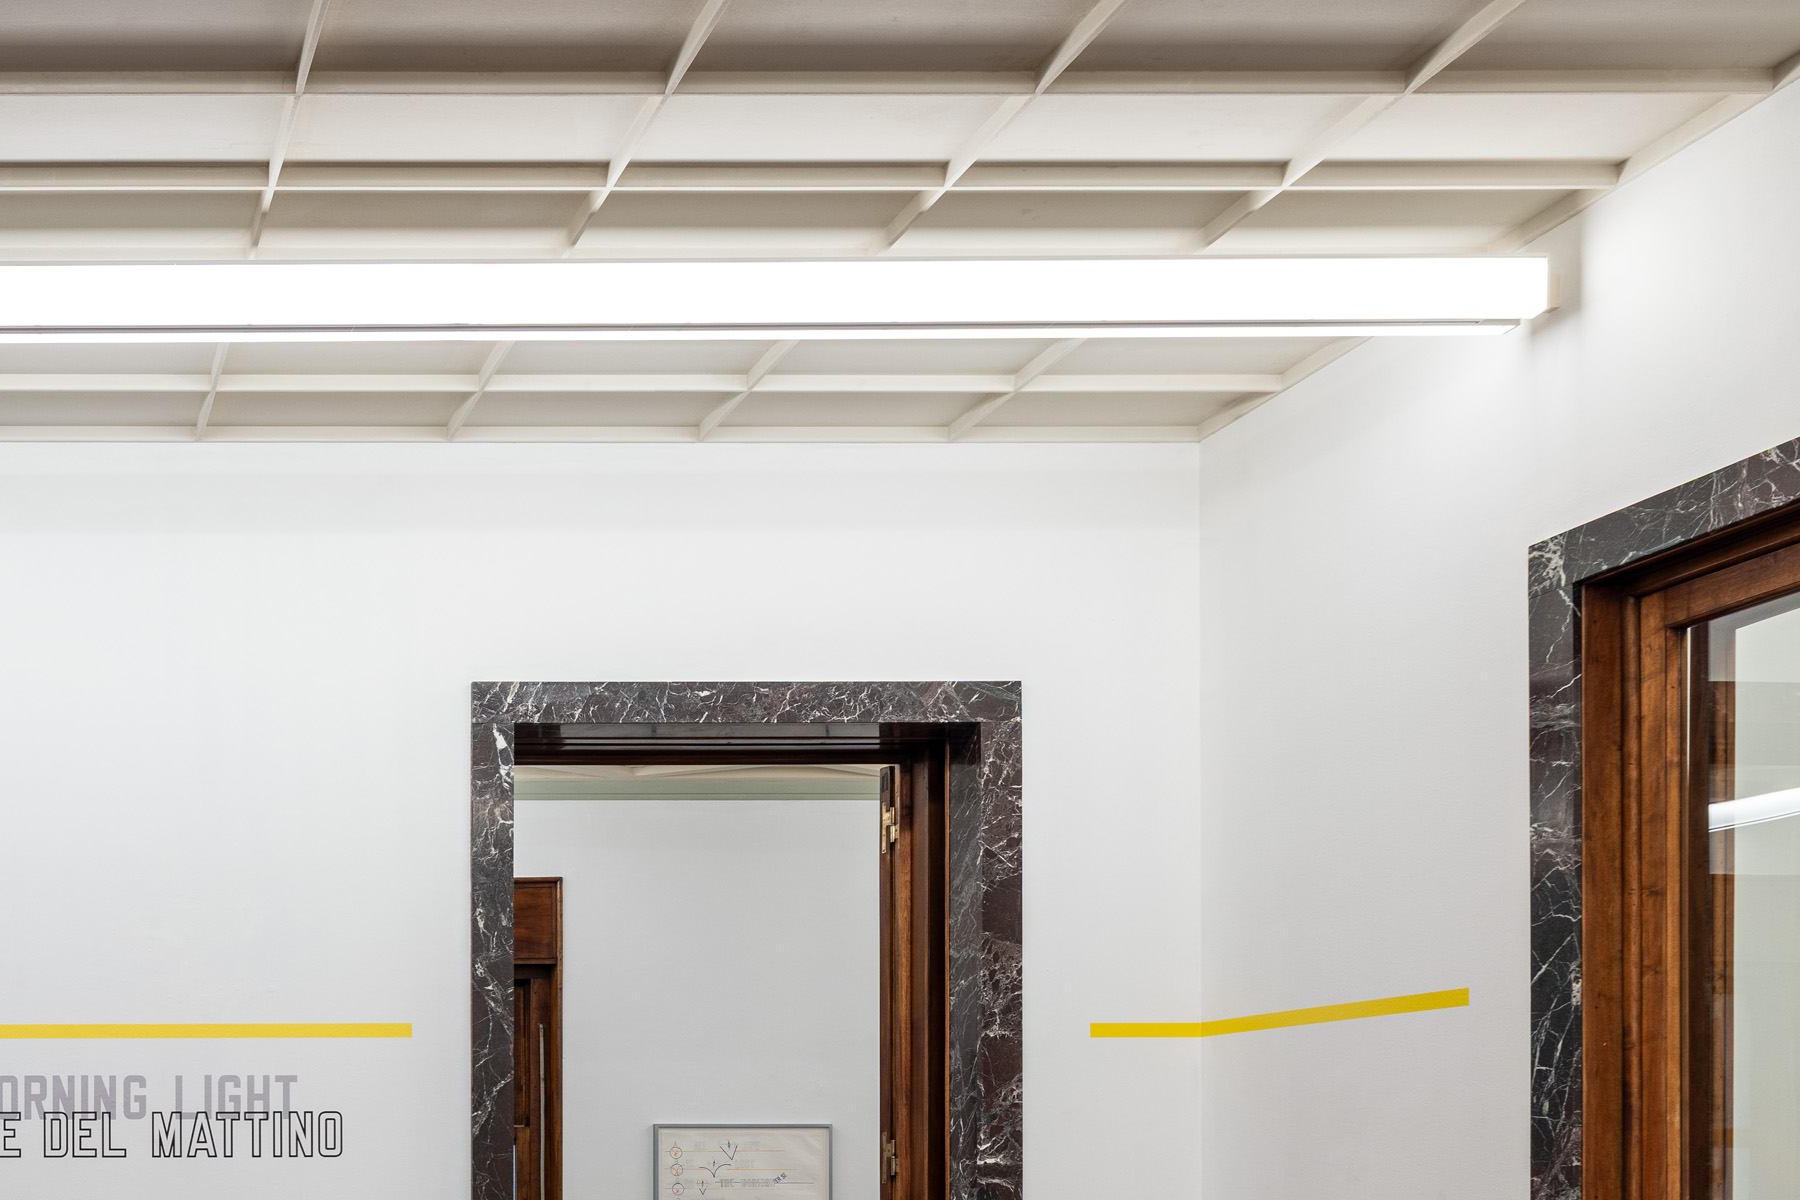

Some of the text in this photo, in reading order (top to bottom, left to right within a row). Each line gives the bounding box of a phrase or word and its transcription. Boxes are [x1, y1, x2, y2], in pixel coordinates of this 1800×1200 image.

[175, 1074, 298, 1120] LIGHT
[43, 1111, 127, 1158] DEL
[151, 1111, 344, 1158] MATTINO
